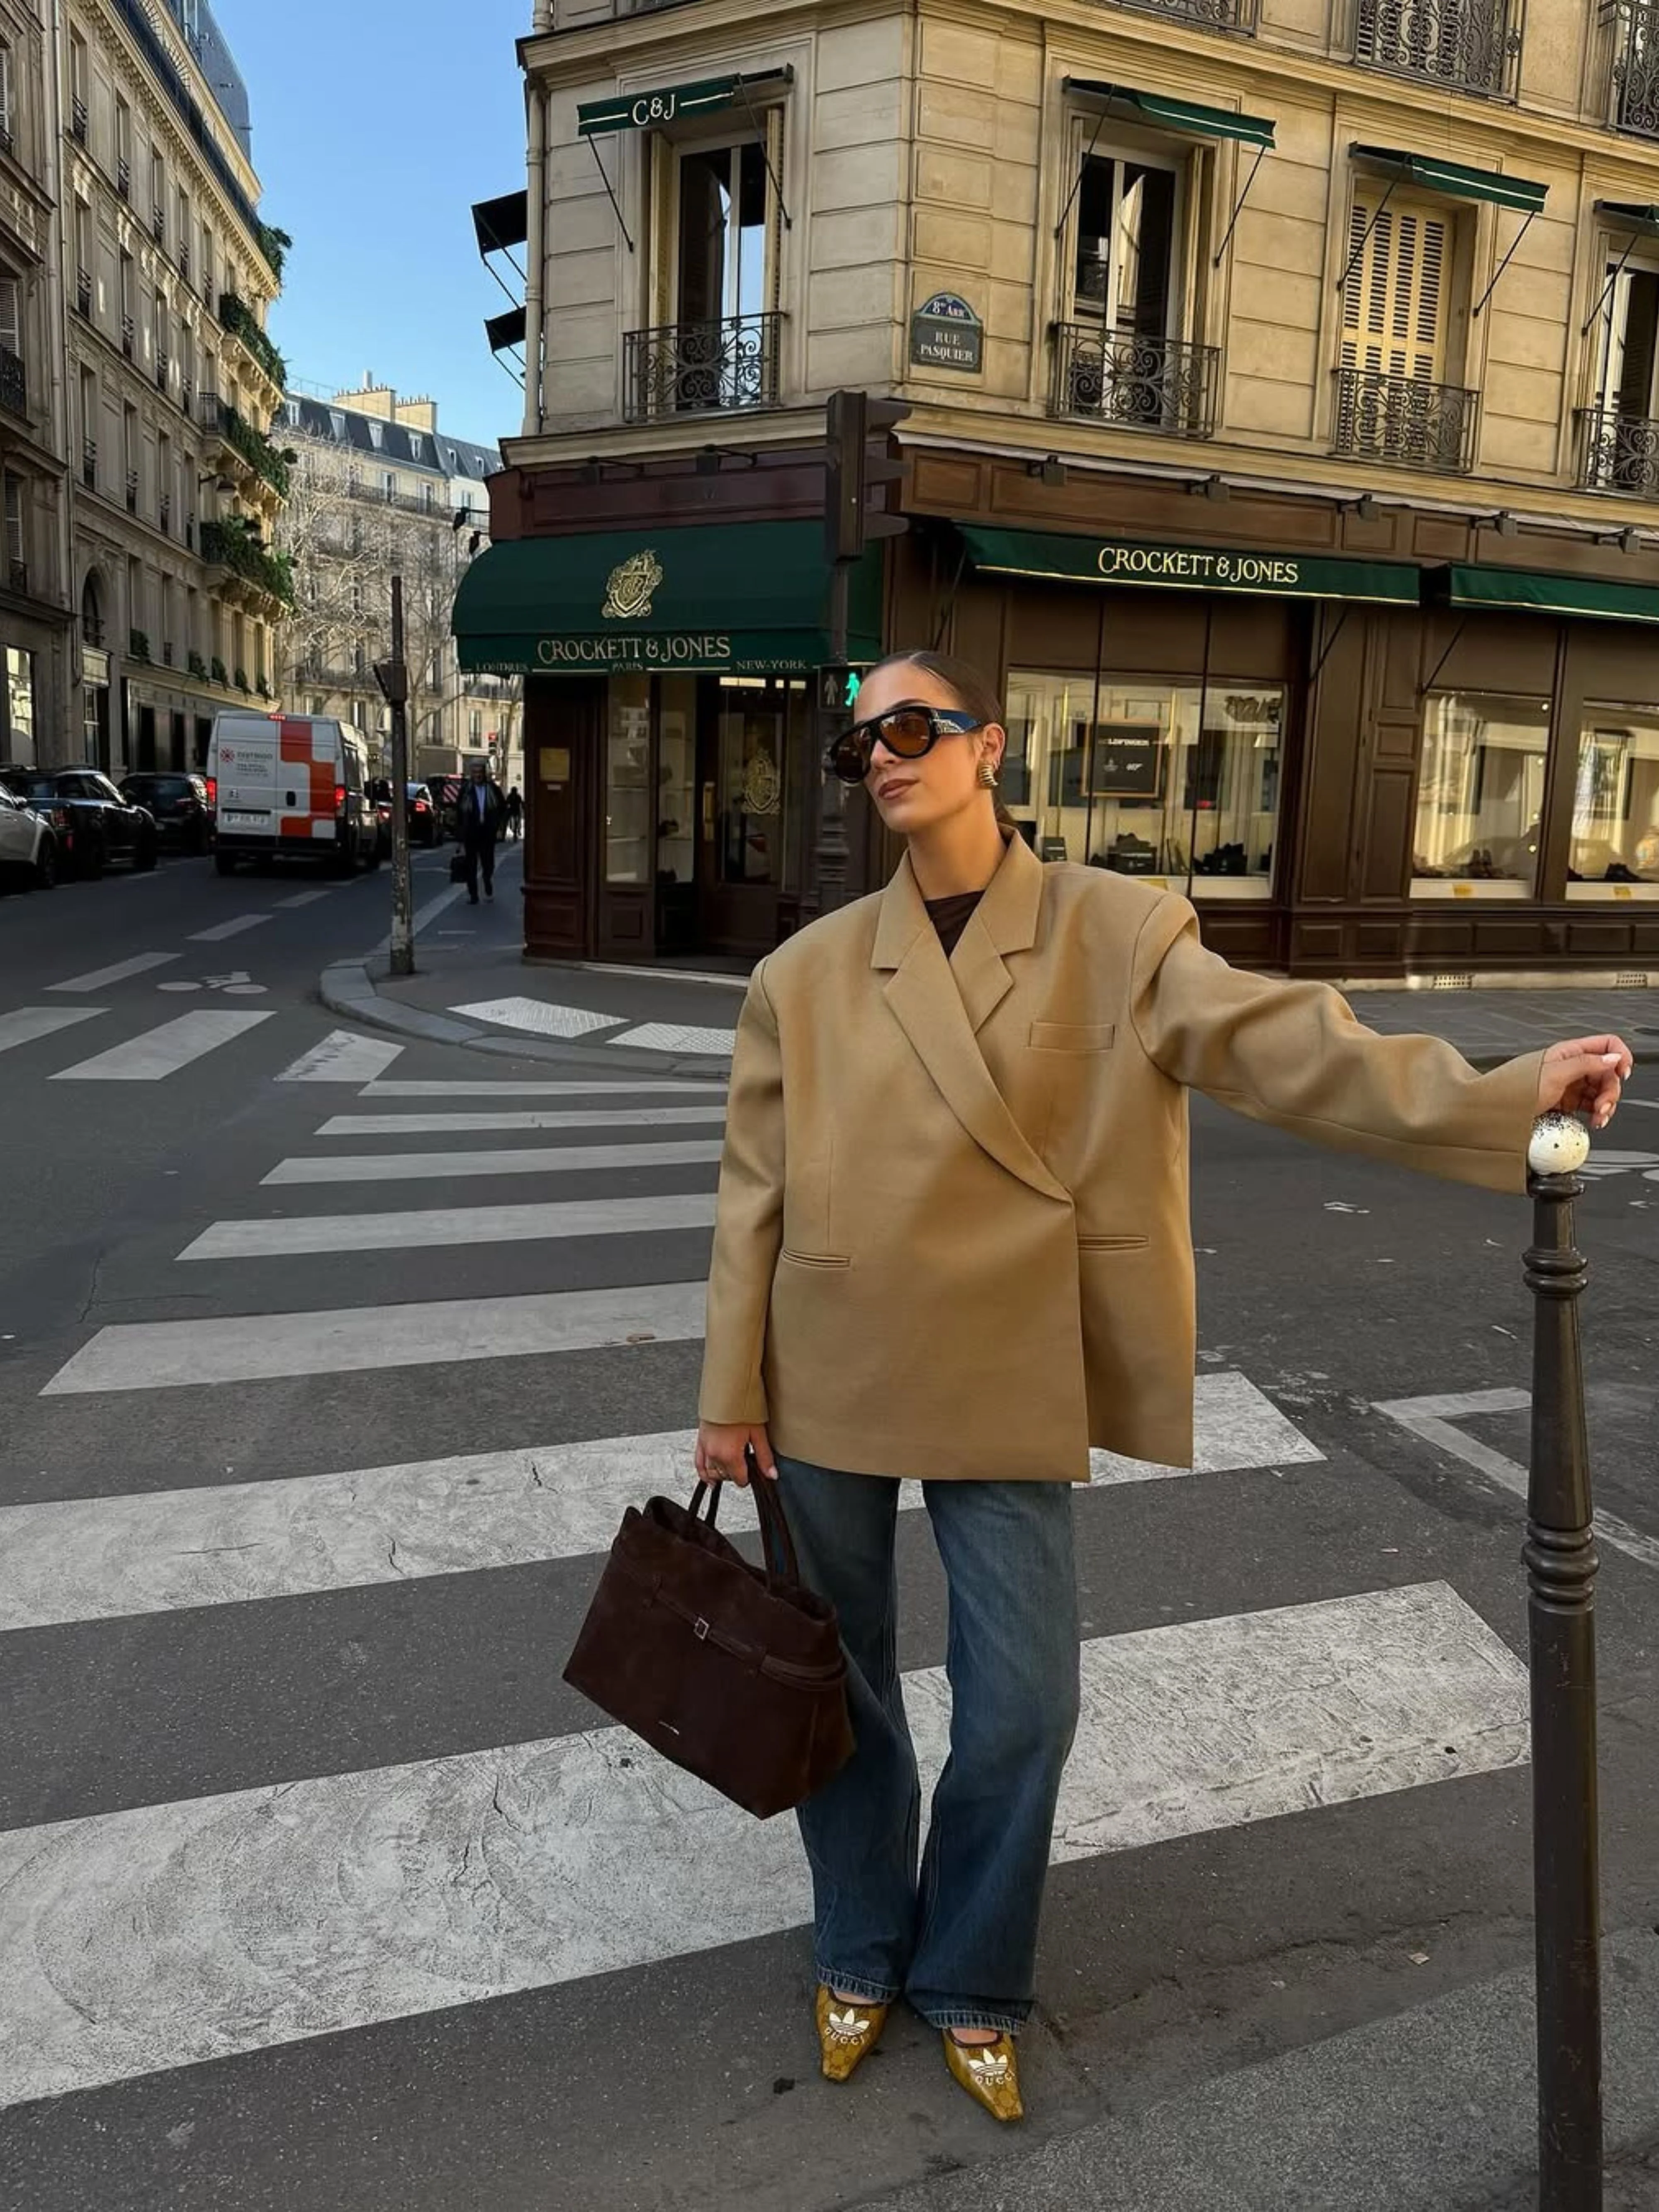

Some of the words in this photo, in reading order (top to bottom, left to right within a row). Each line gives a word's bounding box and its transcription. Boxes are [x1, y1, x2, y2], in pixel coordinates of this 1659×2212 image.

[632, 94, 676, 124] C&J
[935, 331, 961, 345] RUE
[920, 344, 973, 362] PASQUIER
[1098, 547, 1214, 576] CROCKETT
[1216, 557, 1230, 577] &
[1230, 558, 1299, 583] JONES
[538, 637, 642, 664] CROCKETT
[645, 640, 658, 658] &
[660, 636, 731, 662] JONES
[476, 662, 529, 673] LONDRES
[735, 660, 807, 670] NEW-YORK
